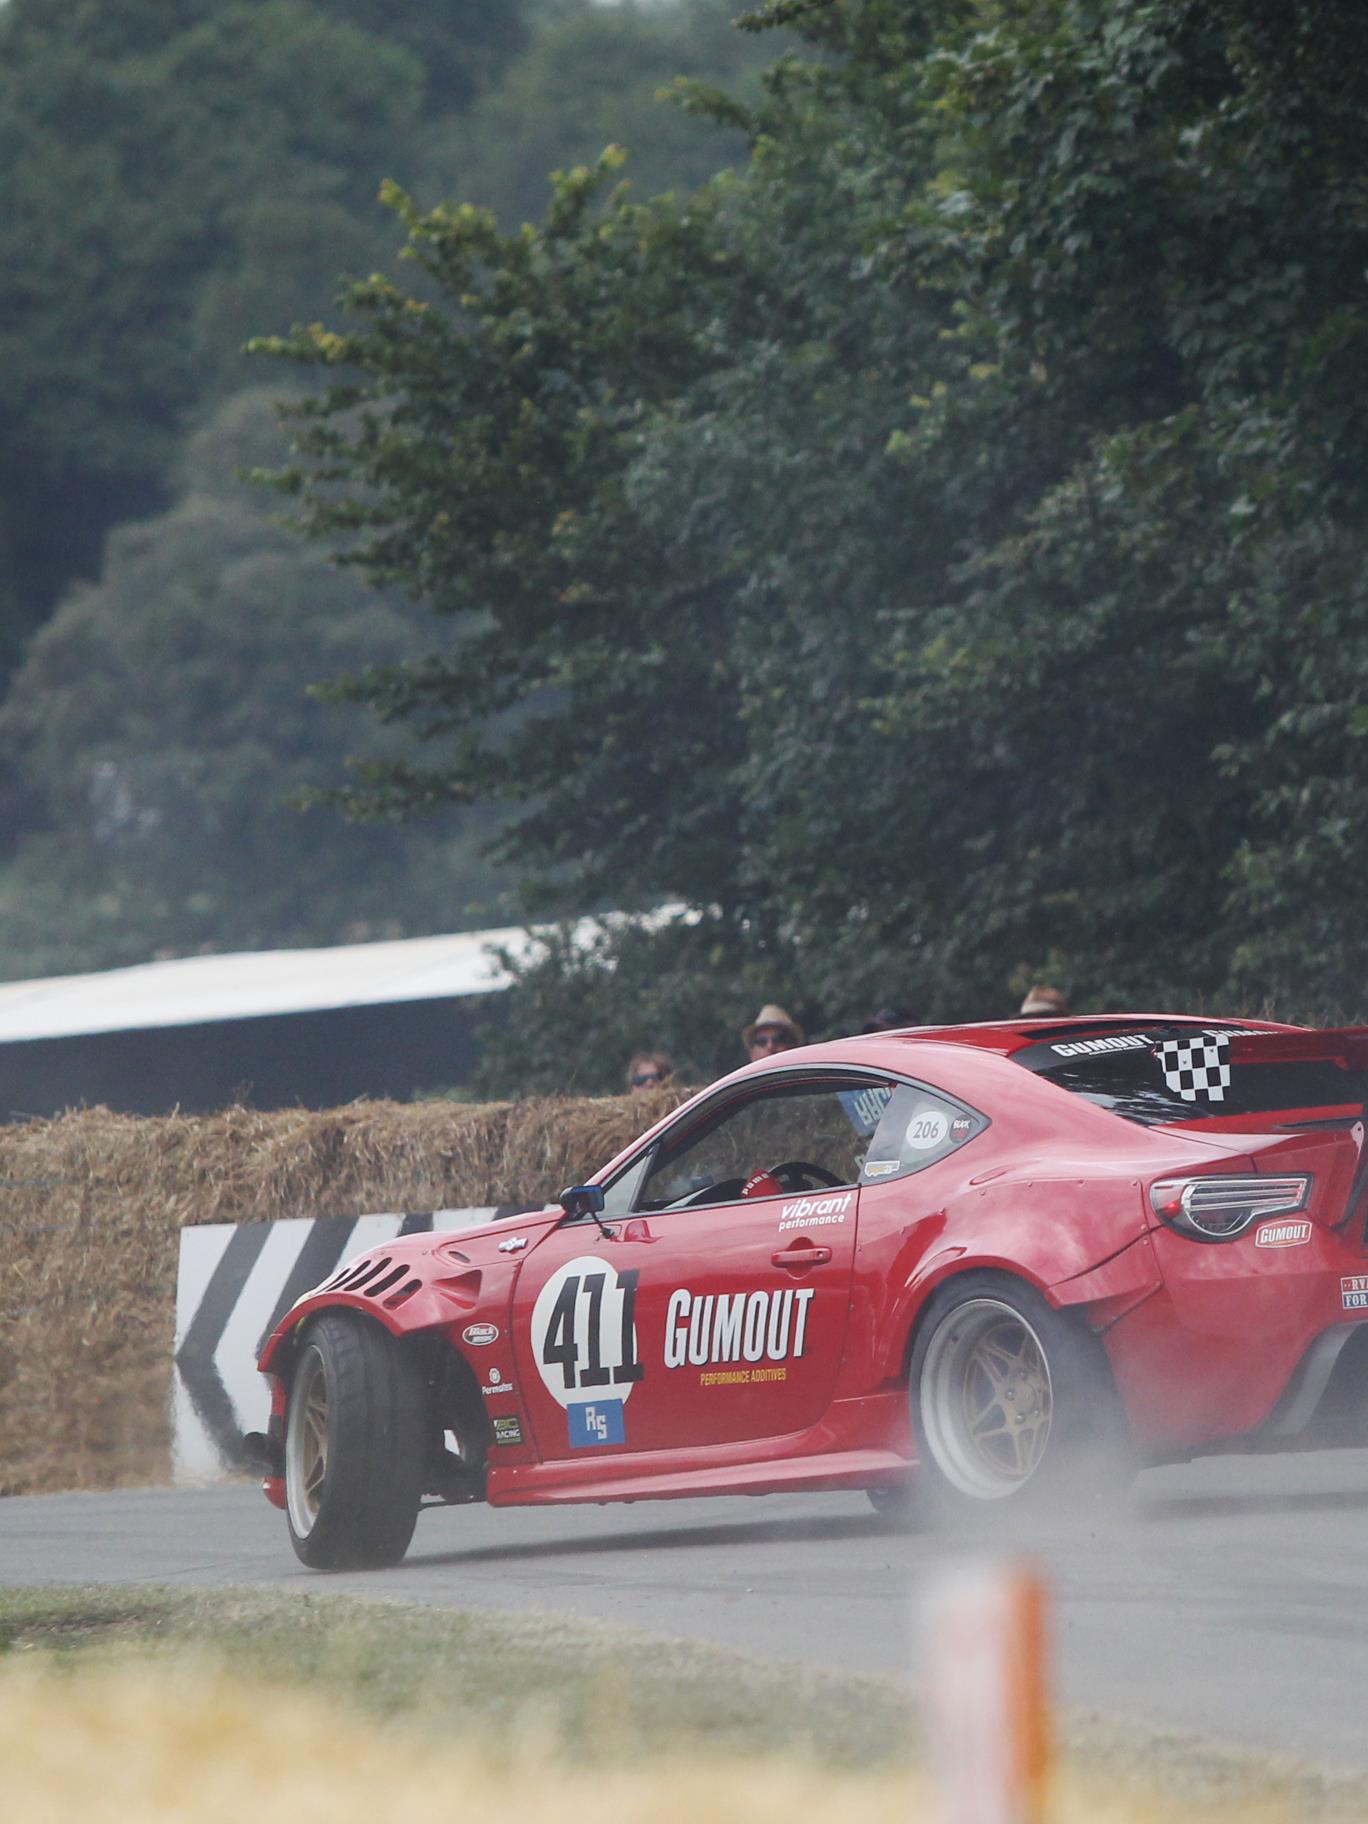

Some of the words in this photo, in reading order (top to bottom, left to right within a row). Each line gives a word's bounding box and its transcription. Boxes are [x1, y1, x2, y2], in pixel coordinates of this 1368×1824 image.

[1050, 1034, 1154, 1058] GUMOUT
[912, 1121, 939, 1139] 206
[781, 1193, 852, 1219] vibrant
[778, 1214, 845, 1233] performance
[1260, 1224, 1308, 1244] GUMOUT
[1345, 1293, 1367, 1307] FOR
[543, 1269, 644, 1389] 411
[663, 1288, 815, 1369] GUMOUT
[700, 1370, 750, 1386] PERFORMANCE
[750, 1367, 787, 1383] ADDITIVES
